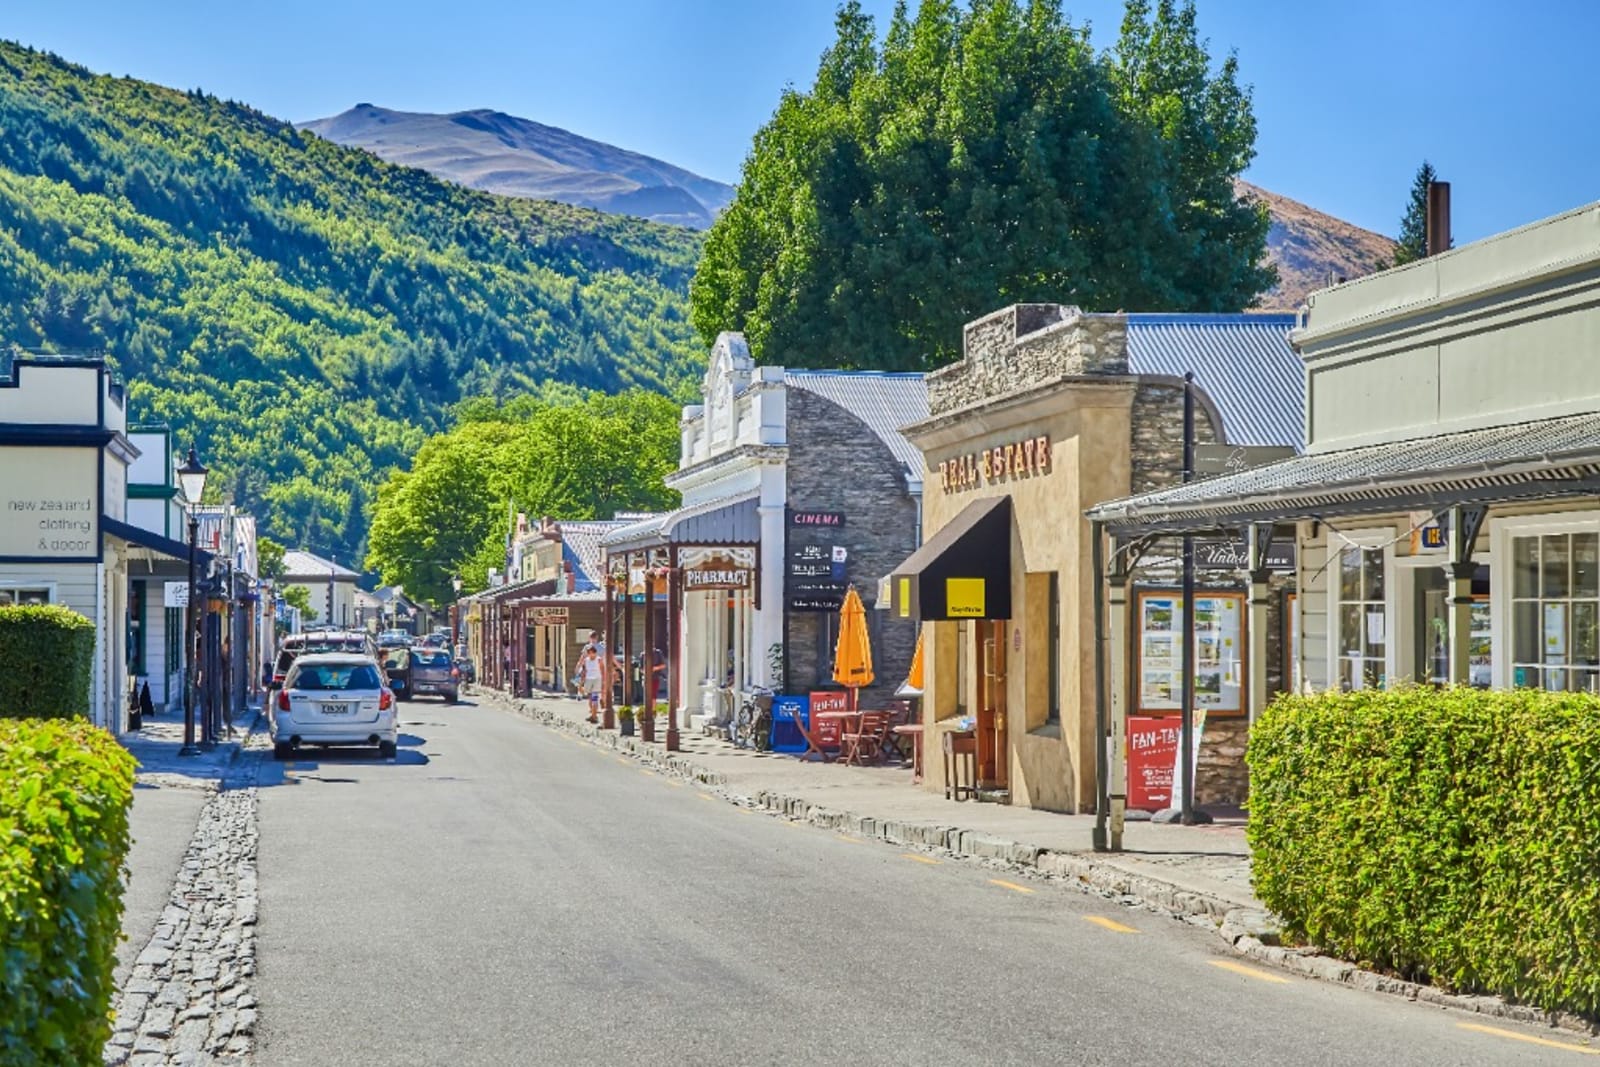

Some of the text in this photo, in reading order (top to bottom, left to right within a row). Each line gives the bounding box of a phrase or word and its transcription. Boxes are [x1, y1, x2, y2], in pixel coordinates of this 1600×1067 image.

[938, 436, 1048, 490] REAL ESTATE
[8, 500, 36, 511] new
[39, 518, 91, 534] clothing
[794, 514, 839, 524] CINEMA
[687, 570, 748, 587] PHARMACY
